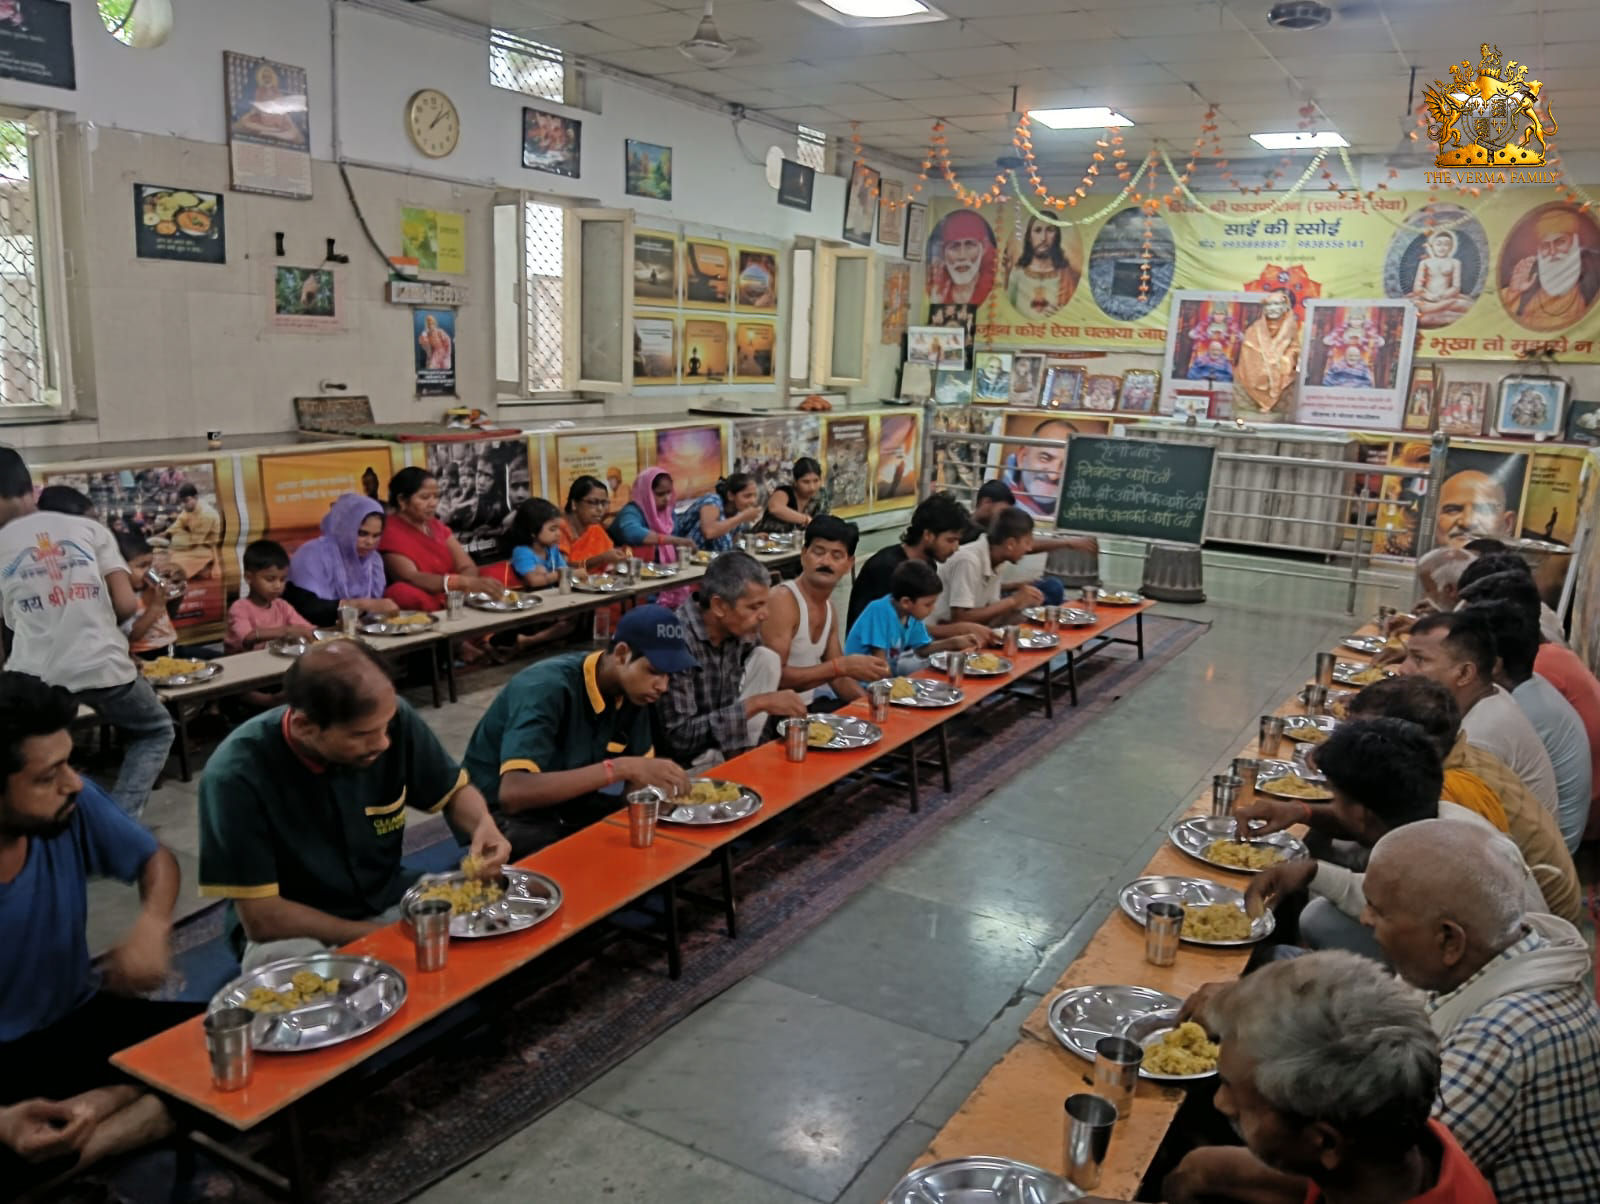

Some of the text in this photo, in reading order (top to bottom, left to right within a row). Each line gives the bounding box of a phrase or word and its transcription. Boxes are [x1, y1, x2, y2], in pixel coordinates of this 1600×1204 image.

[1264, 219, 1290, 236] की
[1015, 322, 1046, 338] कोई
[1051, 322, 1081, 338] ऐसा
[1430, 337, 1477, 357] भूखा
[1482, 334, 1505, 351] तो
[1574, 340, 1593, 353] न
[18, 595, 44, 613] जय
[48, 585, 67, 608] श्री
